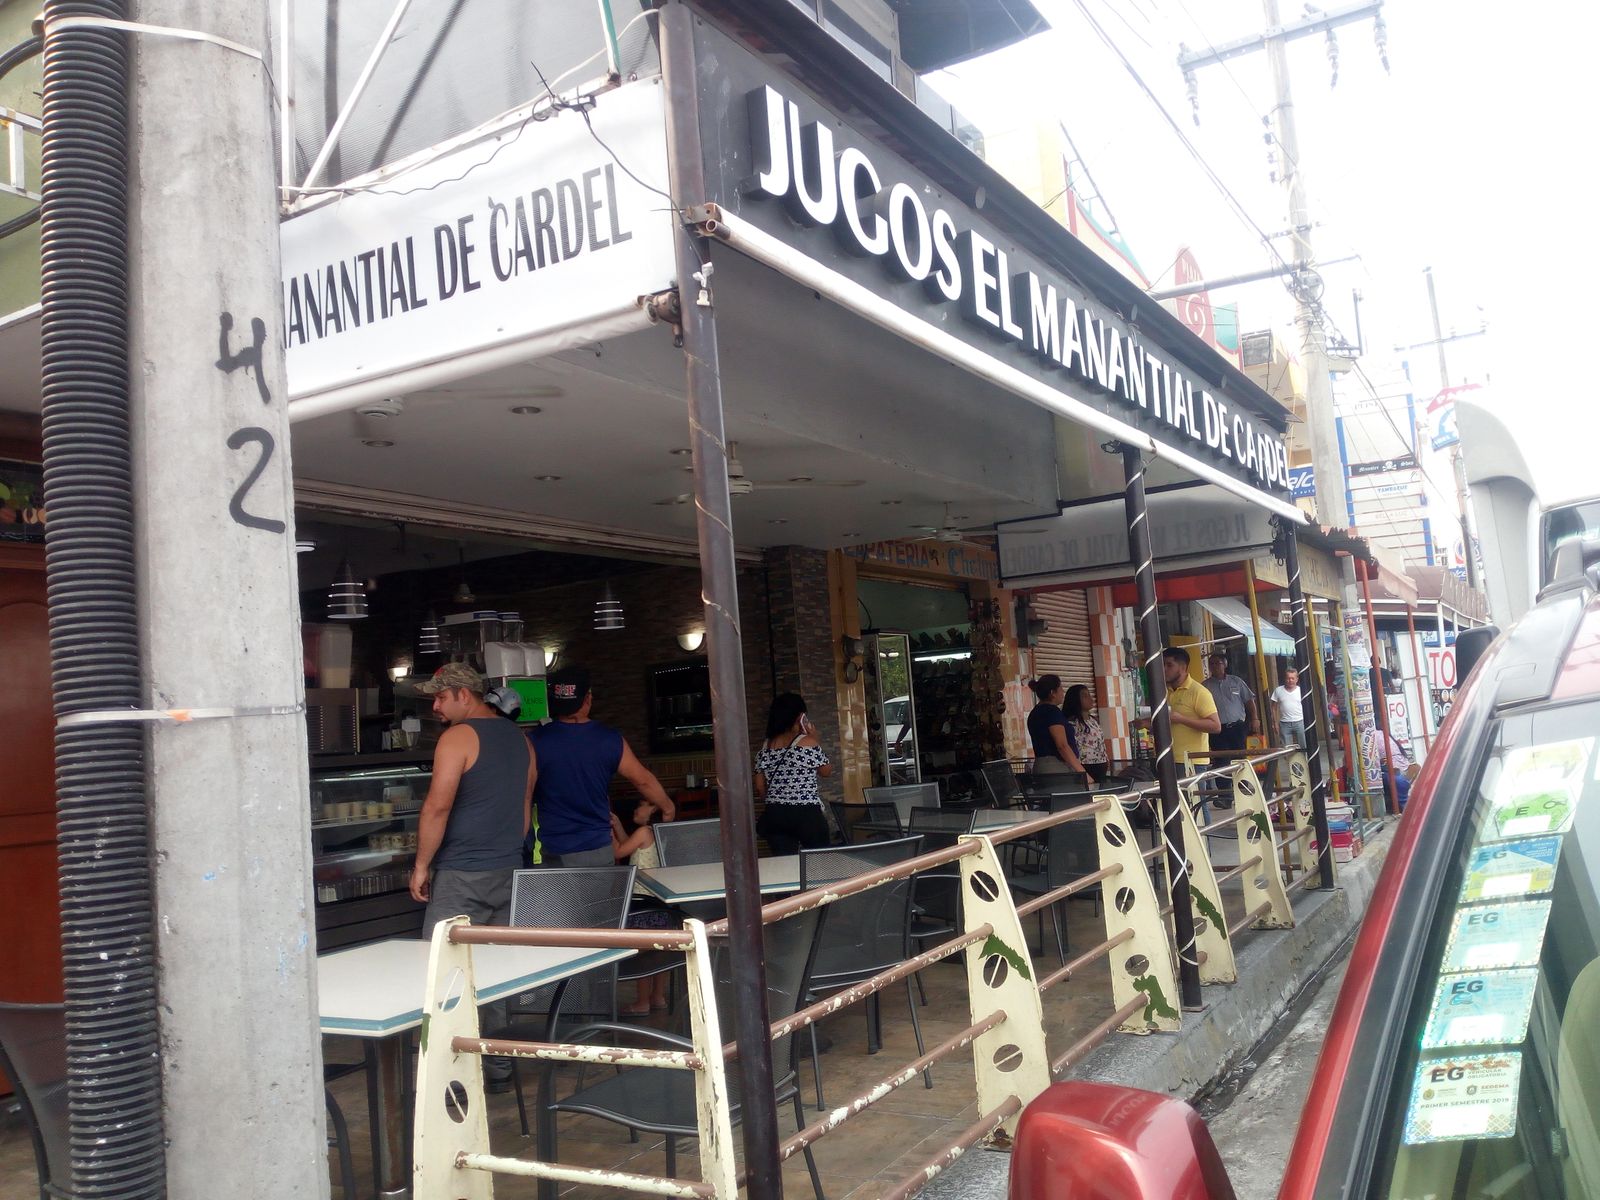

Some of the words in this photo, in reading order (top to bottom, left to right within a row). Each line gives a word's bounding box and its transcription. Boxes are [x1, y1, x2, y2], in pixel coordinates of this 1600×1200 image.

[281, 236, 427, 349] ANANTIAL
[433, 214, 481, 300] DE
[489, 163, 632, 282] CARDEL
[760, 84, 962, 300] JUGOS
[970, 229, 1023, 340] EL
[1029, 271, 1201, 441] MANANTIAL
[1202, 390, 1232, 458] DE
[215, 311, 271, 404] 4
[226, 426, 285, 534] 2
[1478, 850, 1507, 862] EG
[1468, 912, 1499, 925] EG
[1451, 980, 1483, 995] EG
[1431, 1066, 1464, 1083] EG
